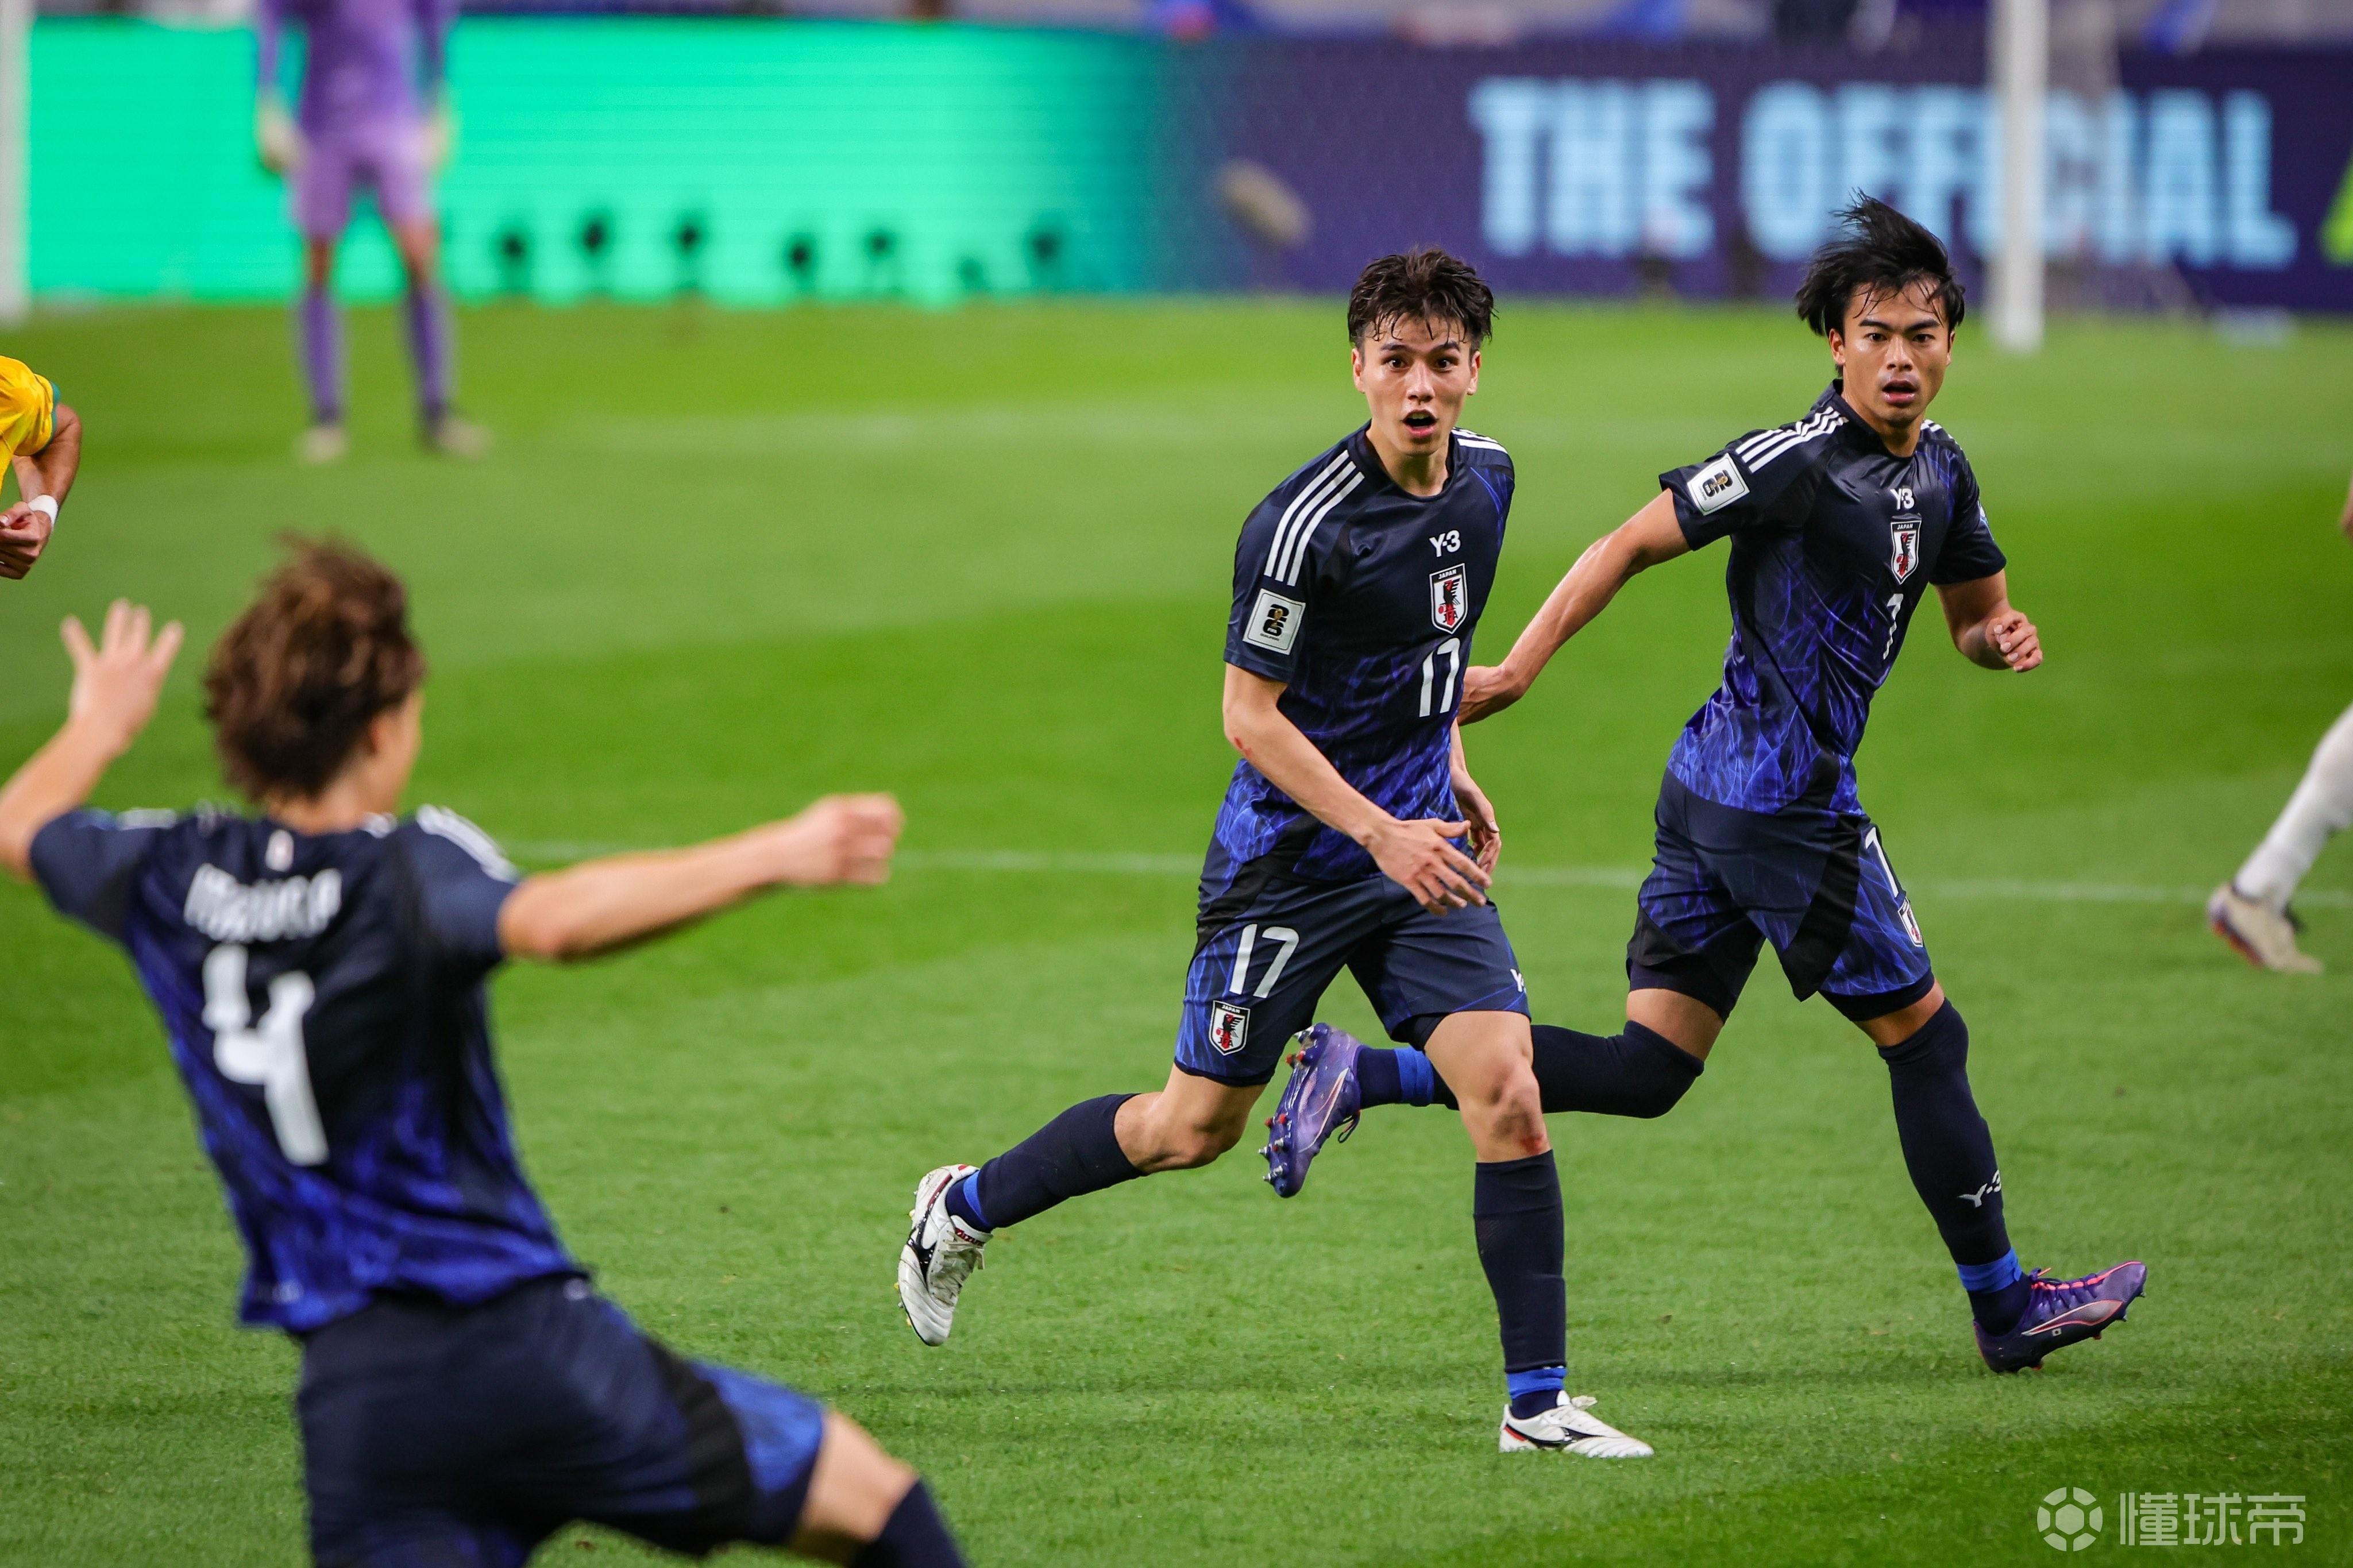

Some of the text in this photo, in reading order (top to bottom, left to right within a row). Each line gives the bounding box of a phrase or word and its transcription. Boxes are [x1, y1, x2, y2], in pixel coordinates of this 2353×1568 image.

[1472, 75, 1714, 259] THE
[1890, 488, 1915, 509] Y-3
[1429, 530, 1461, 558] Y-3
[1438, 569, 1457, 580] JAPAN
[1883, 593, 1904, 660] 7
[1419, 638, 1460, 717] 17
[1228, 923, 1299, 998] 17
[1221, 1004, 1241, 1014] JAPAN
[202, 943, 330, 1167] 4
[1957, 1169, 2001, 1208] Y-3
